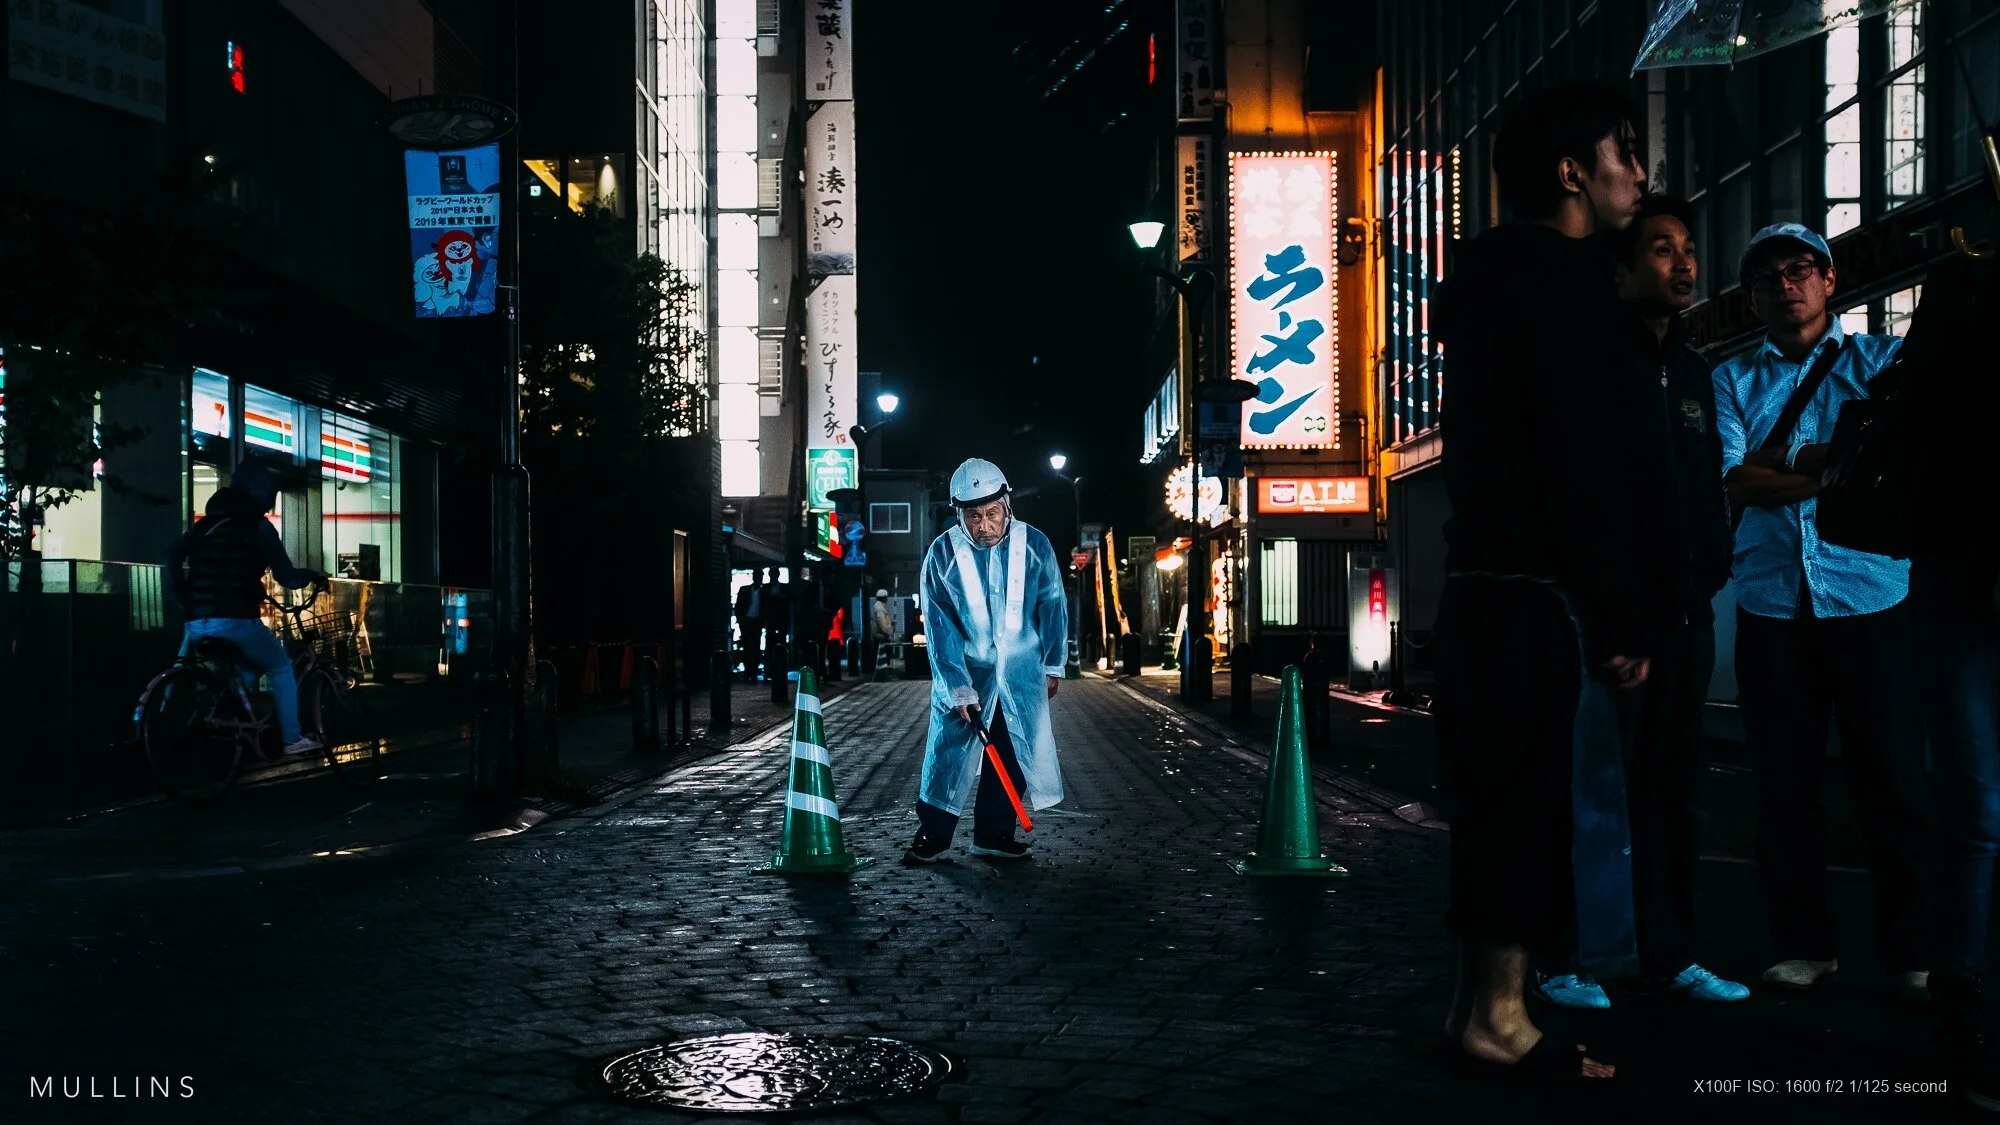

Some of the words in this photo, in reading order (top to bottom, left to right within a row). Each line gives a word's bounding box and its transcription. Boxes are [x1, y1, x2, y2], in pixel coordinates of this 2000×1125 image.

[452, 98, 500, 119] CHOME
[415, 195, 494, 206] ラグビーワールドカップ
[1299, 481, 1356, 501] ATM
